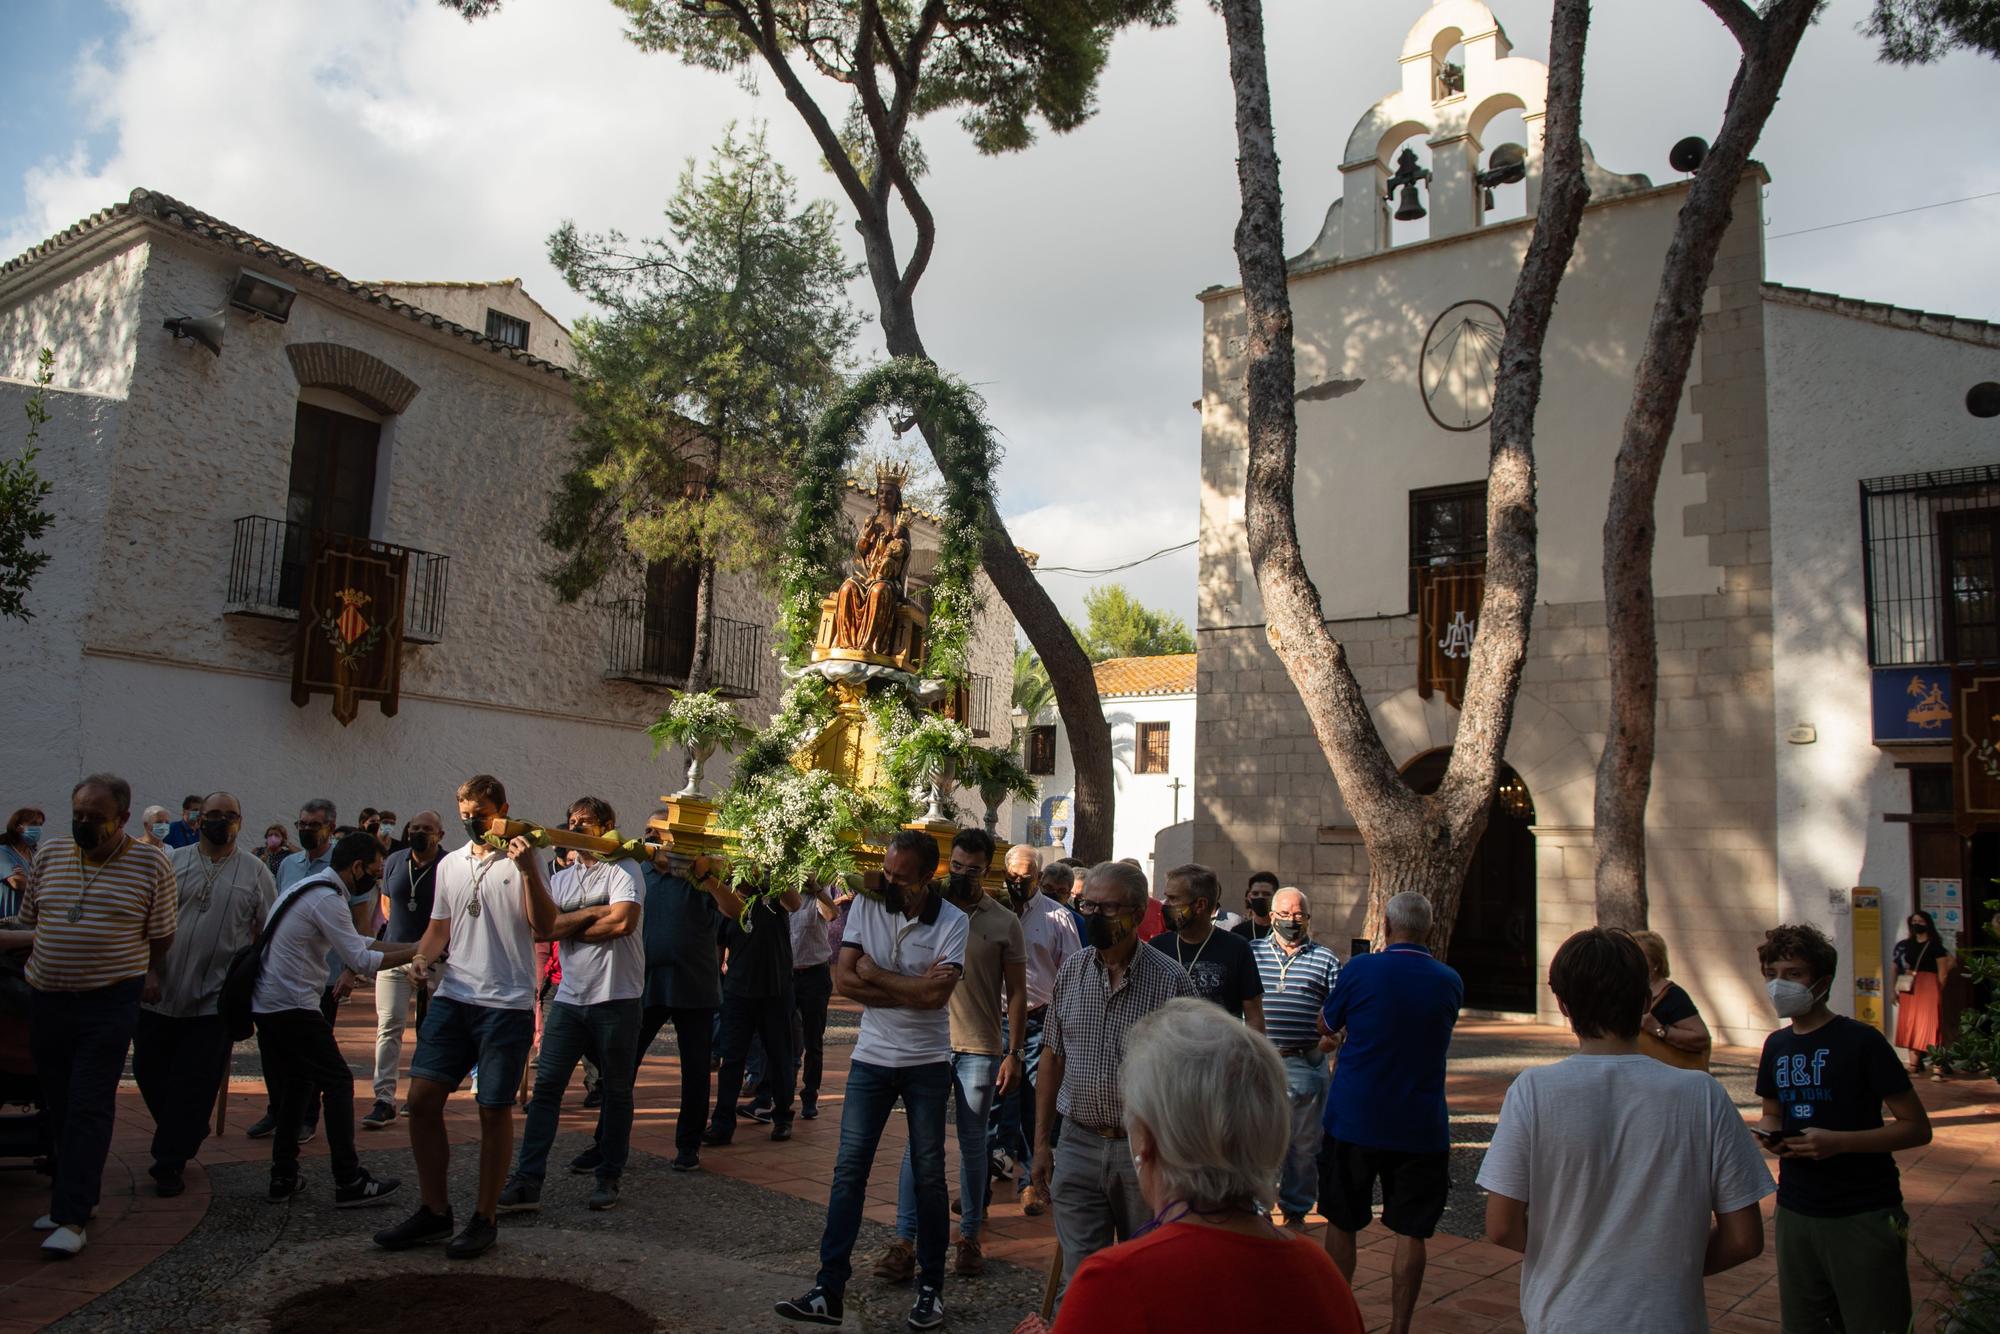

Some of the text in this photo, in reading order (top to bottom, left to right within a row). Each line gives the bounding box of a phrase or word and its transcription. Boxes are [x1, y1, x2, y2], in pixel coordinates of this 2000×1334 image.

[1776, 1049, 1830, 1088] a&f
[1801, 1088, 1832, 1101] YORK
[1794, 1104, 1811, 1117] 92
